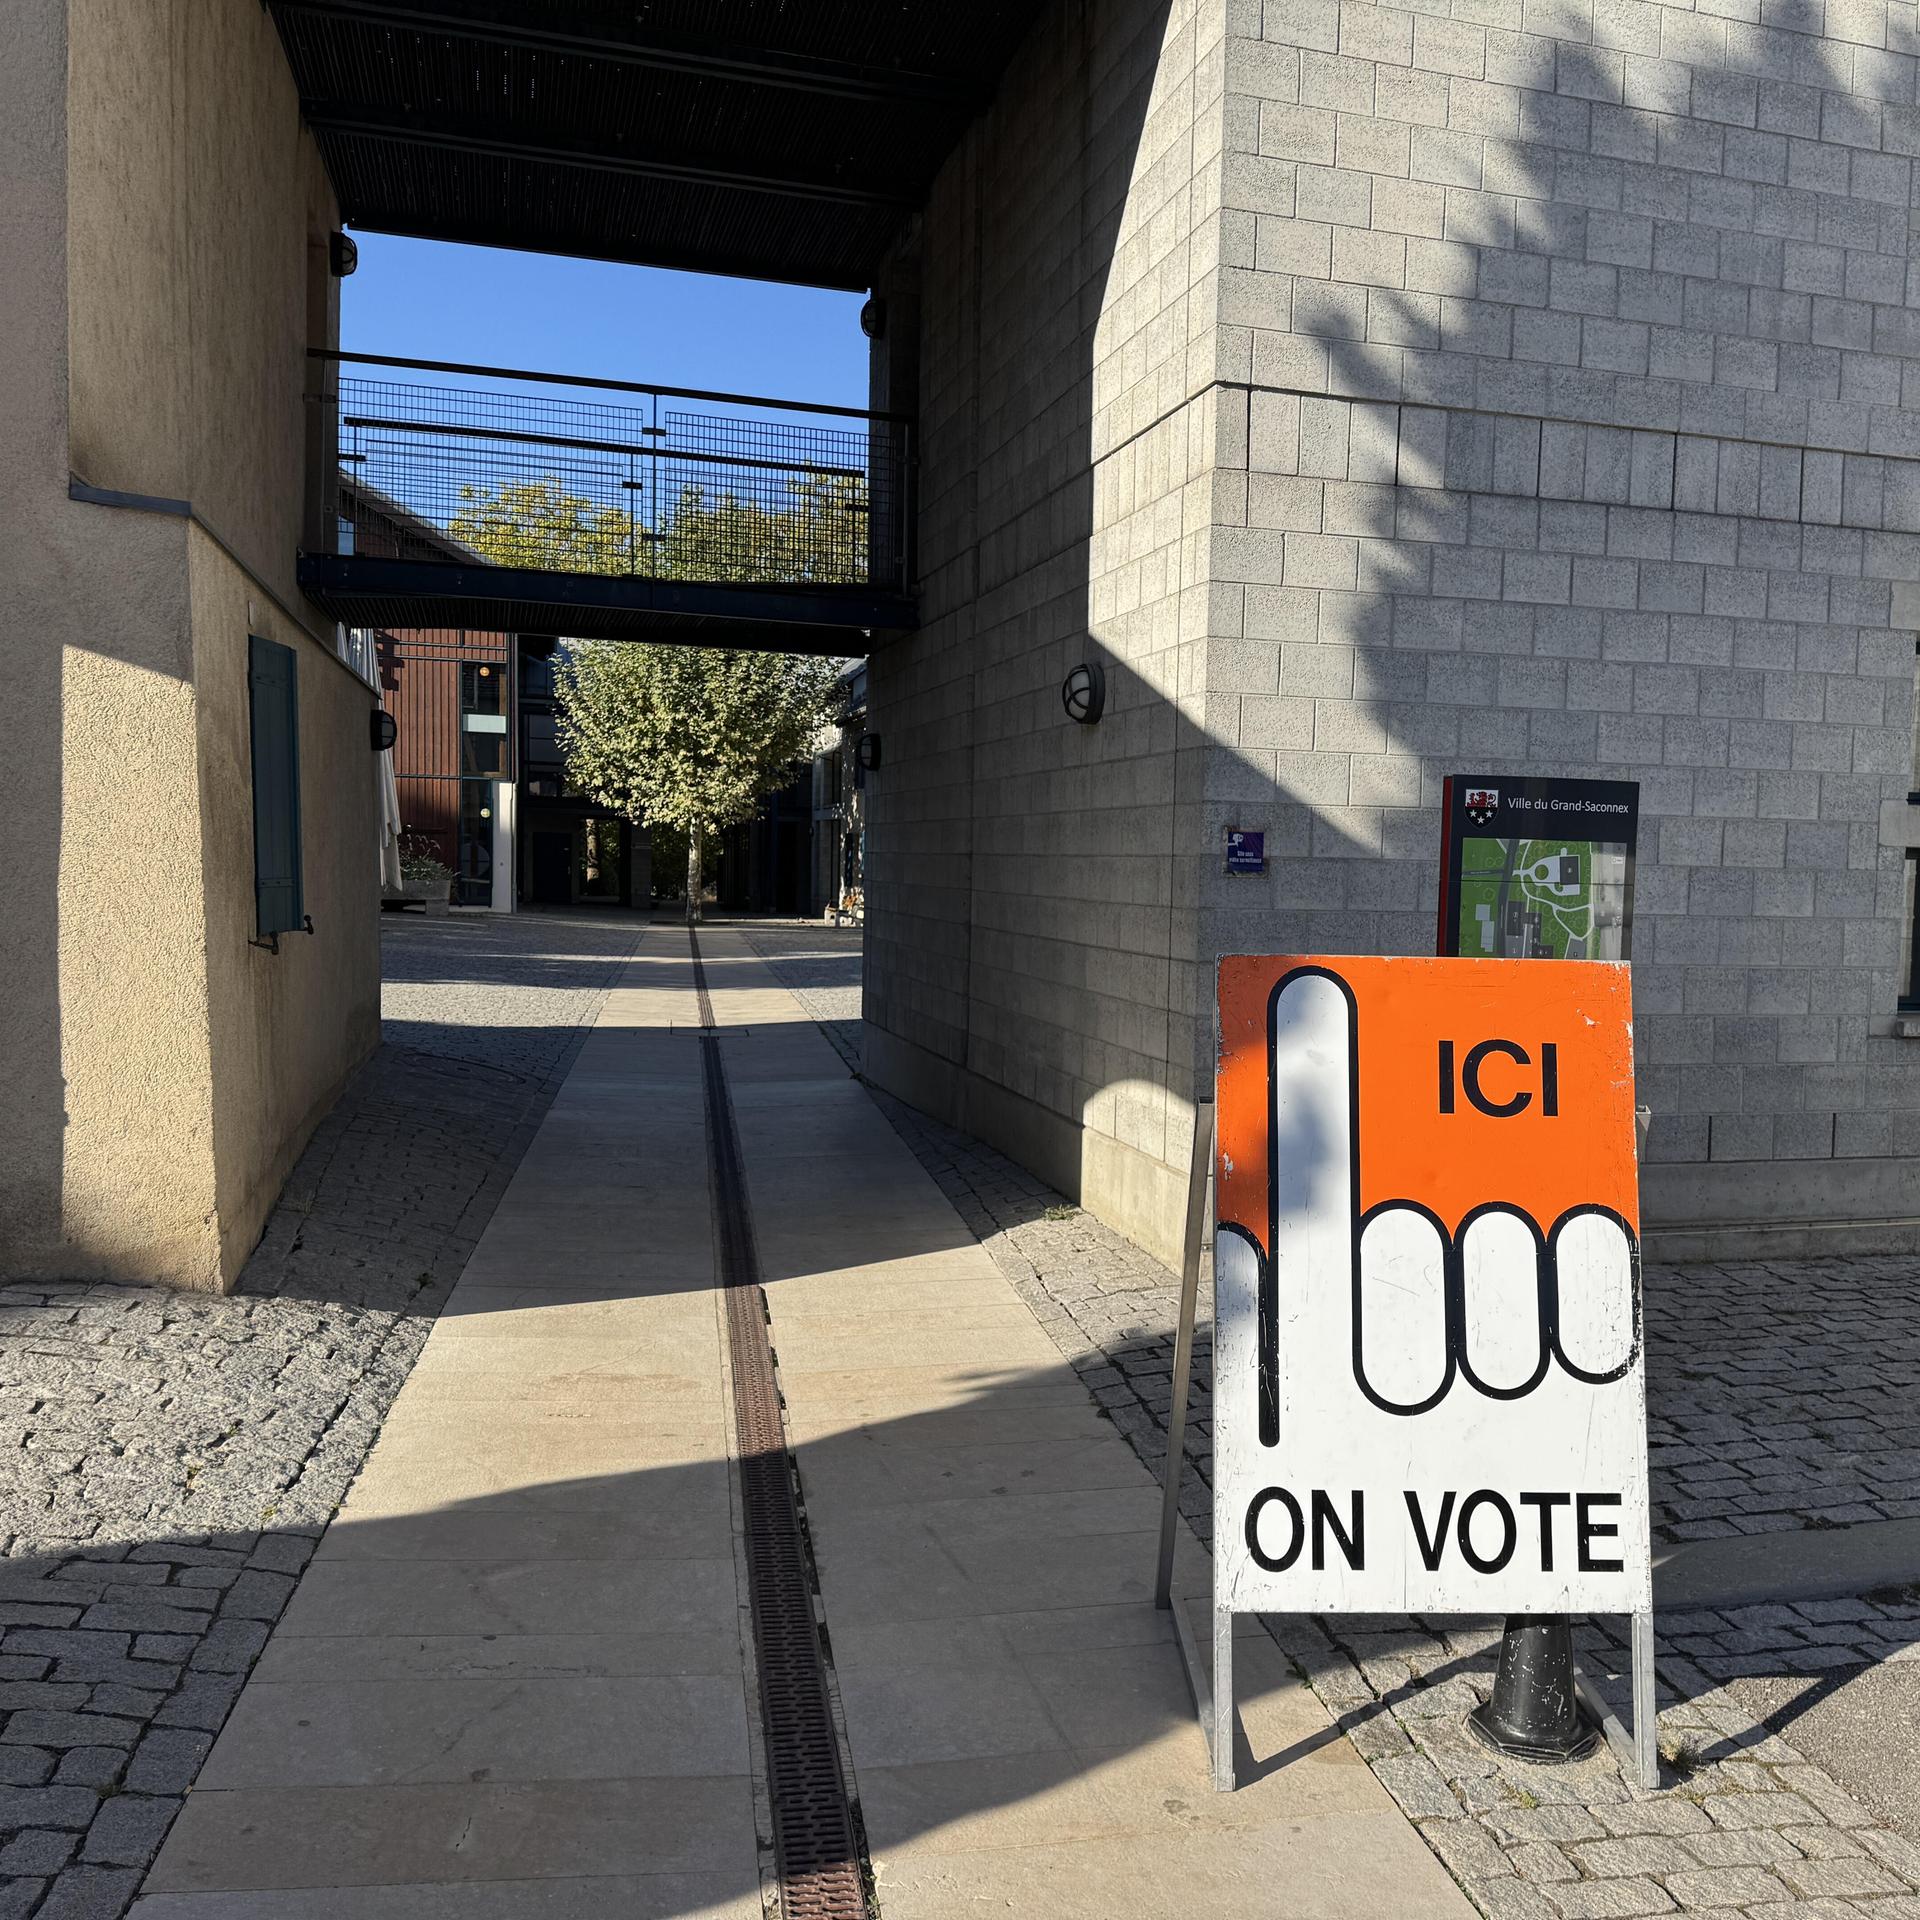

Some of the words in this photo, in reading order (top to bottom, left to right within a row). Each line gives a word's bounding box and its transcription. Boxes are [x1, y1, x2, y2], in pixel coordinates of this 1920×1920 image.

[1507, 797, 1531, 809] Ville
[1534, 798, 1548, 810] du
[1551, 799, 1629, 814] Grand-Saconnex
[1438, 1039, 1559, 1118] ICI
[1245, 1486, 1365, 1573] ON
[1404, 1489, 1624, 1575] VOTE
